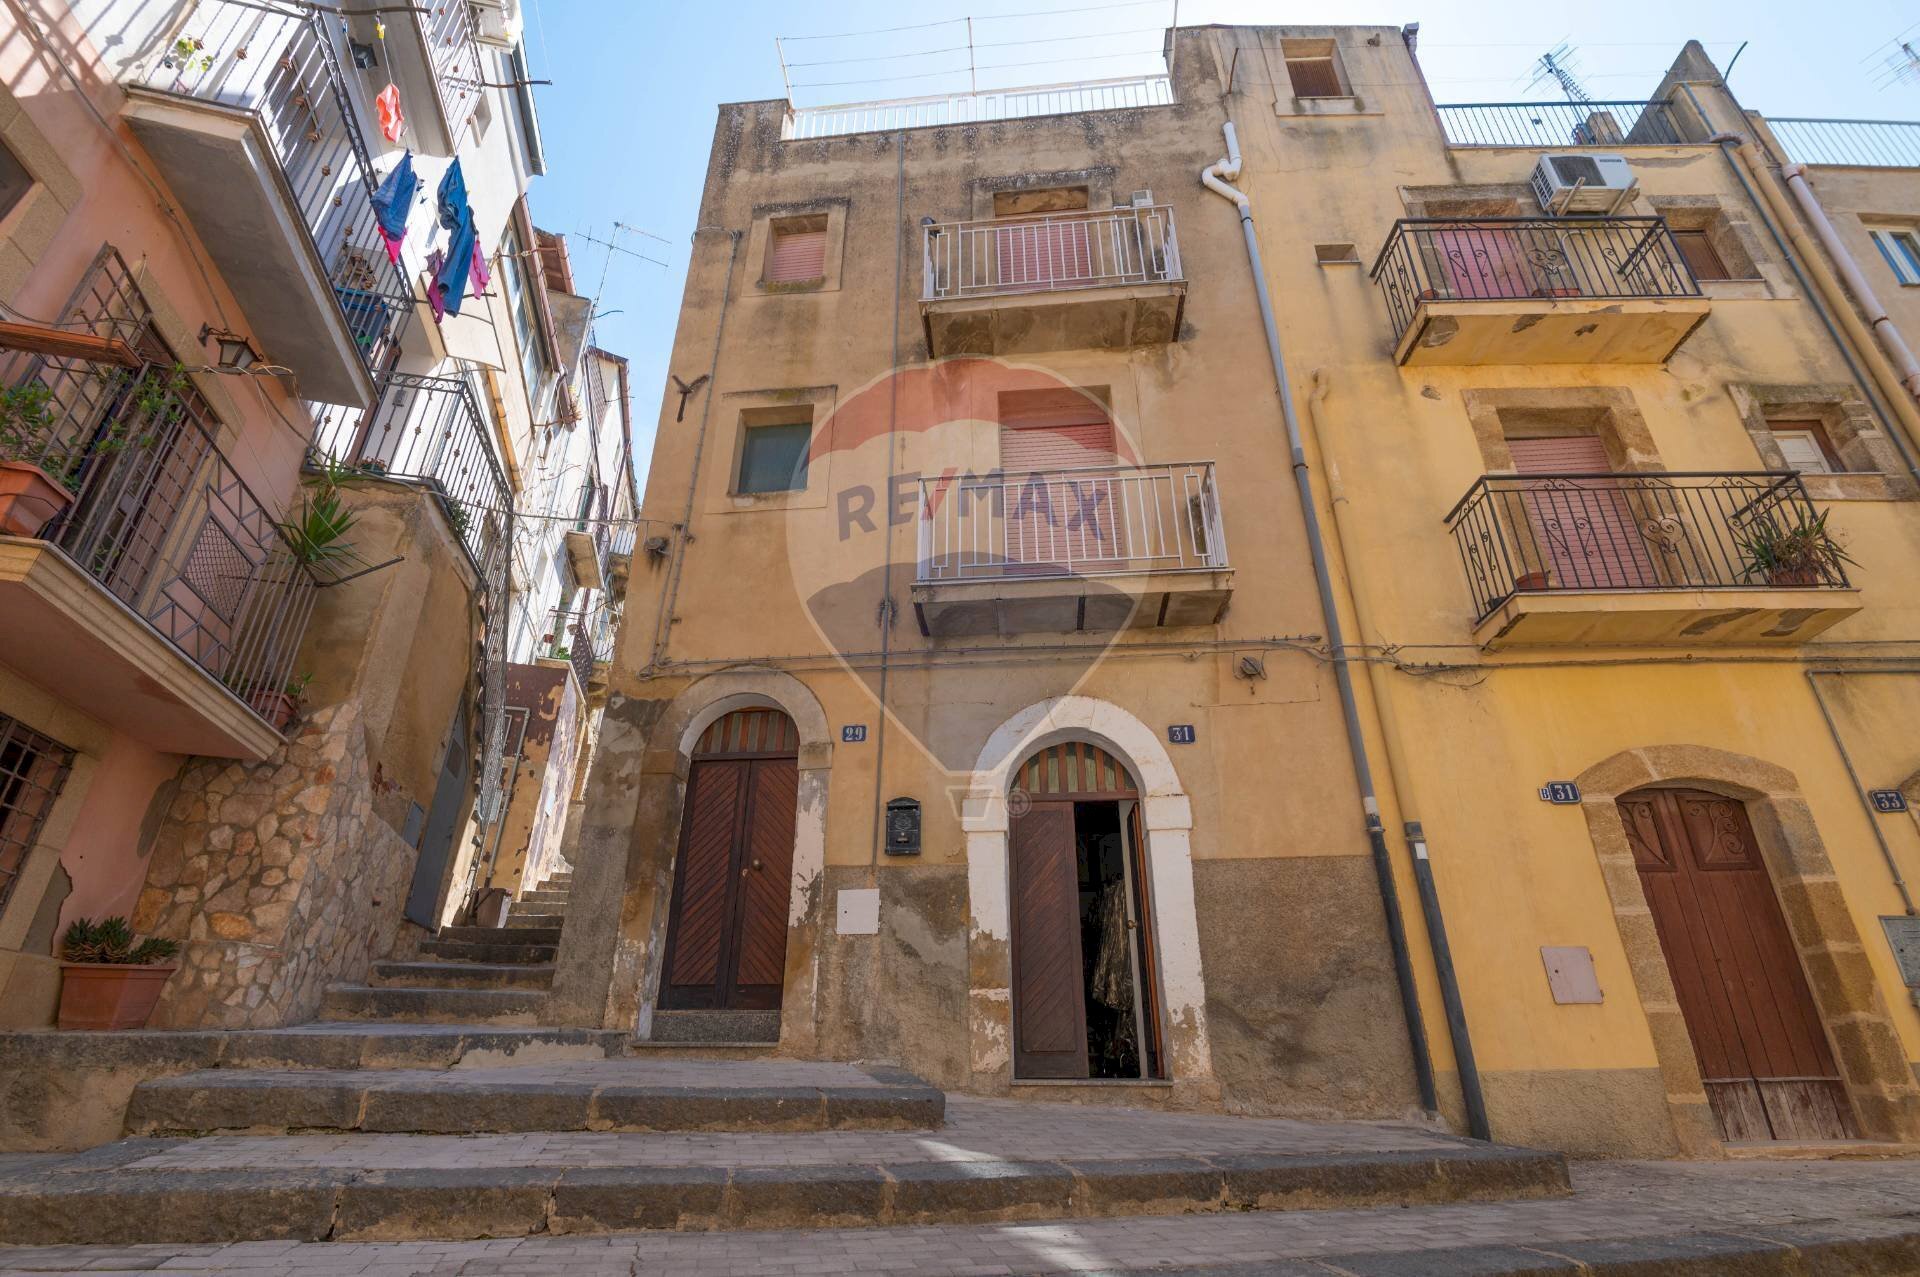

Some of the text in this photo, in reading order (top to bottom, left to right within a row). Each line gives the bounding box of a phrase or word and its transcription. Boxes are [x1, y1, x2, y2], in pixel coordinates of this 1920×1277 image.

[845, 727, 863, 741] 29
[1172, 726, 1189, 741] 31
[1554, 784, 1574, 800] 31
[1877, 793, 1900, 808] 33
